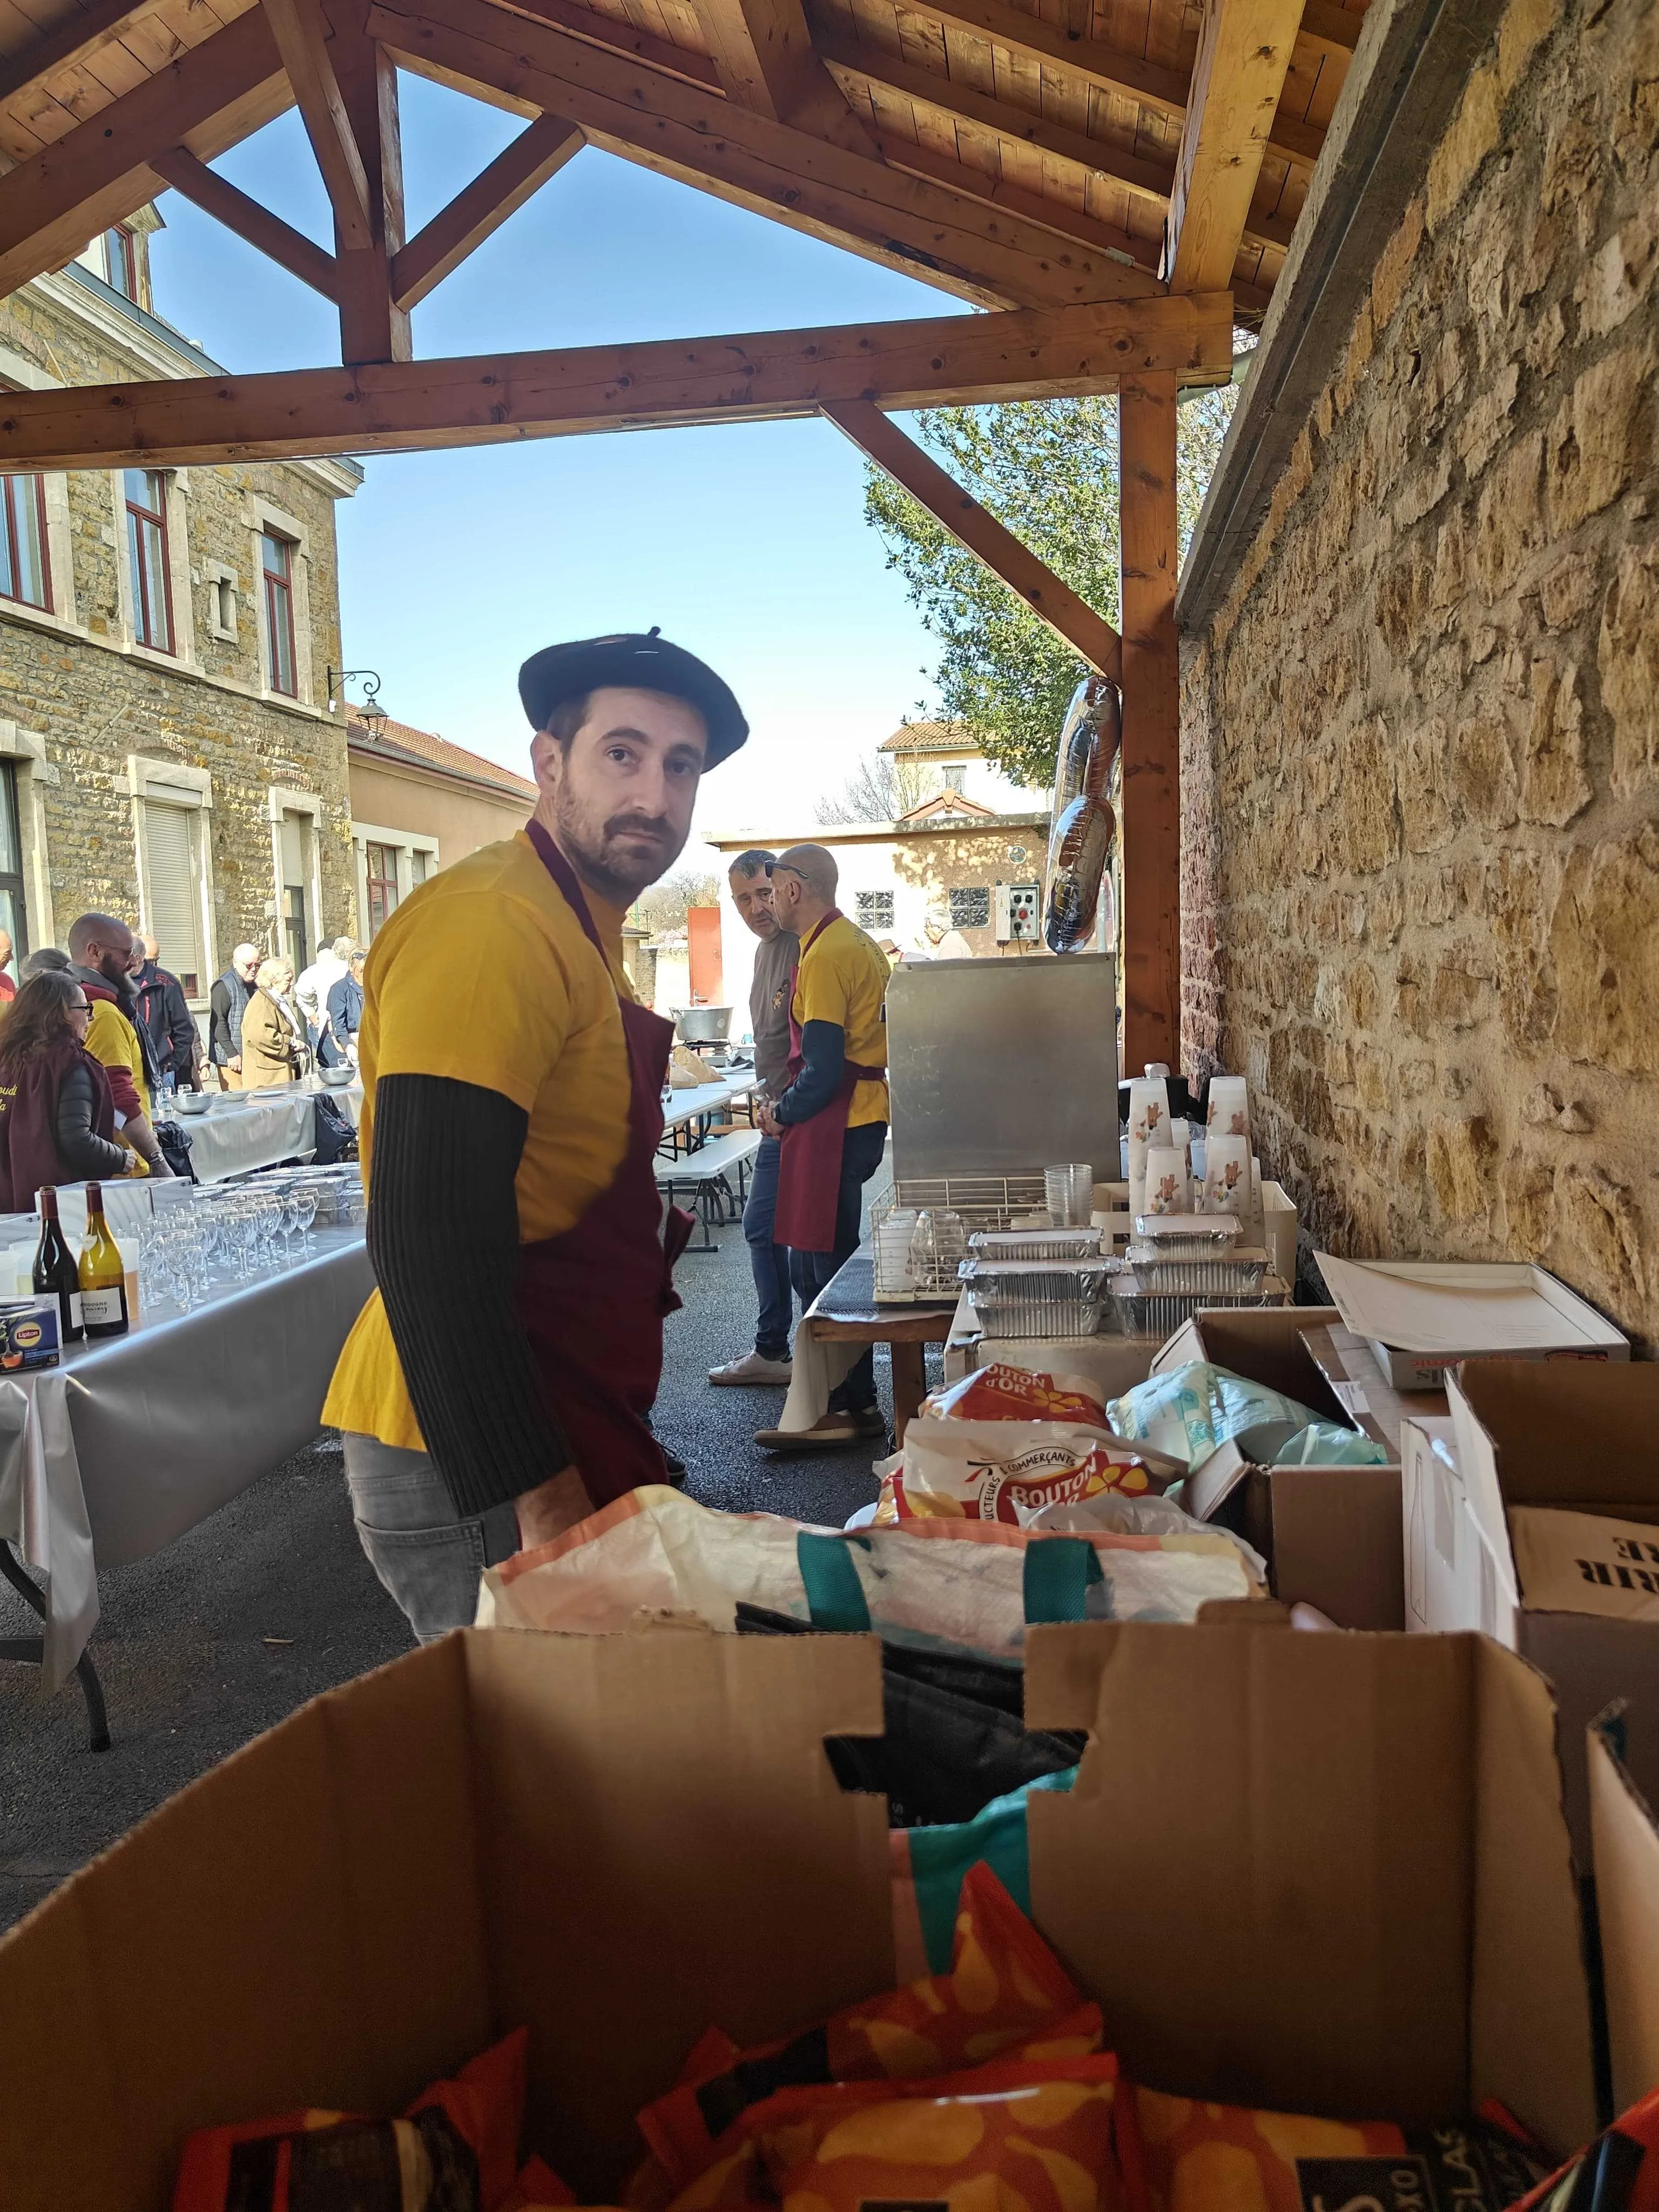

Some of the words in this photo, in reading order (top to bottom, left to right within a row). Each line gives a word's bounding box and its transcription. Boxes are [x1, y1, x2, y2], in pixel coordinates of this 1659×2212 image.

[986, 1364, 1046, 1388] OUTON
[984, 1477, 1000, 1520] UCTEURS
[1008, 1452, 1076, 1472] COMMERÇANTS
[1011, 1456, 1097, 1507] BOUTON
